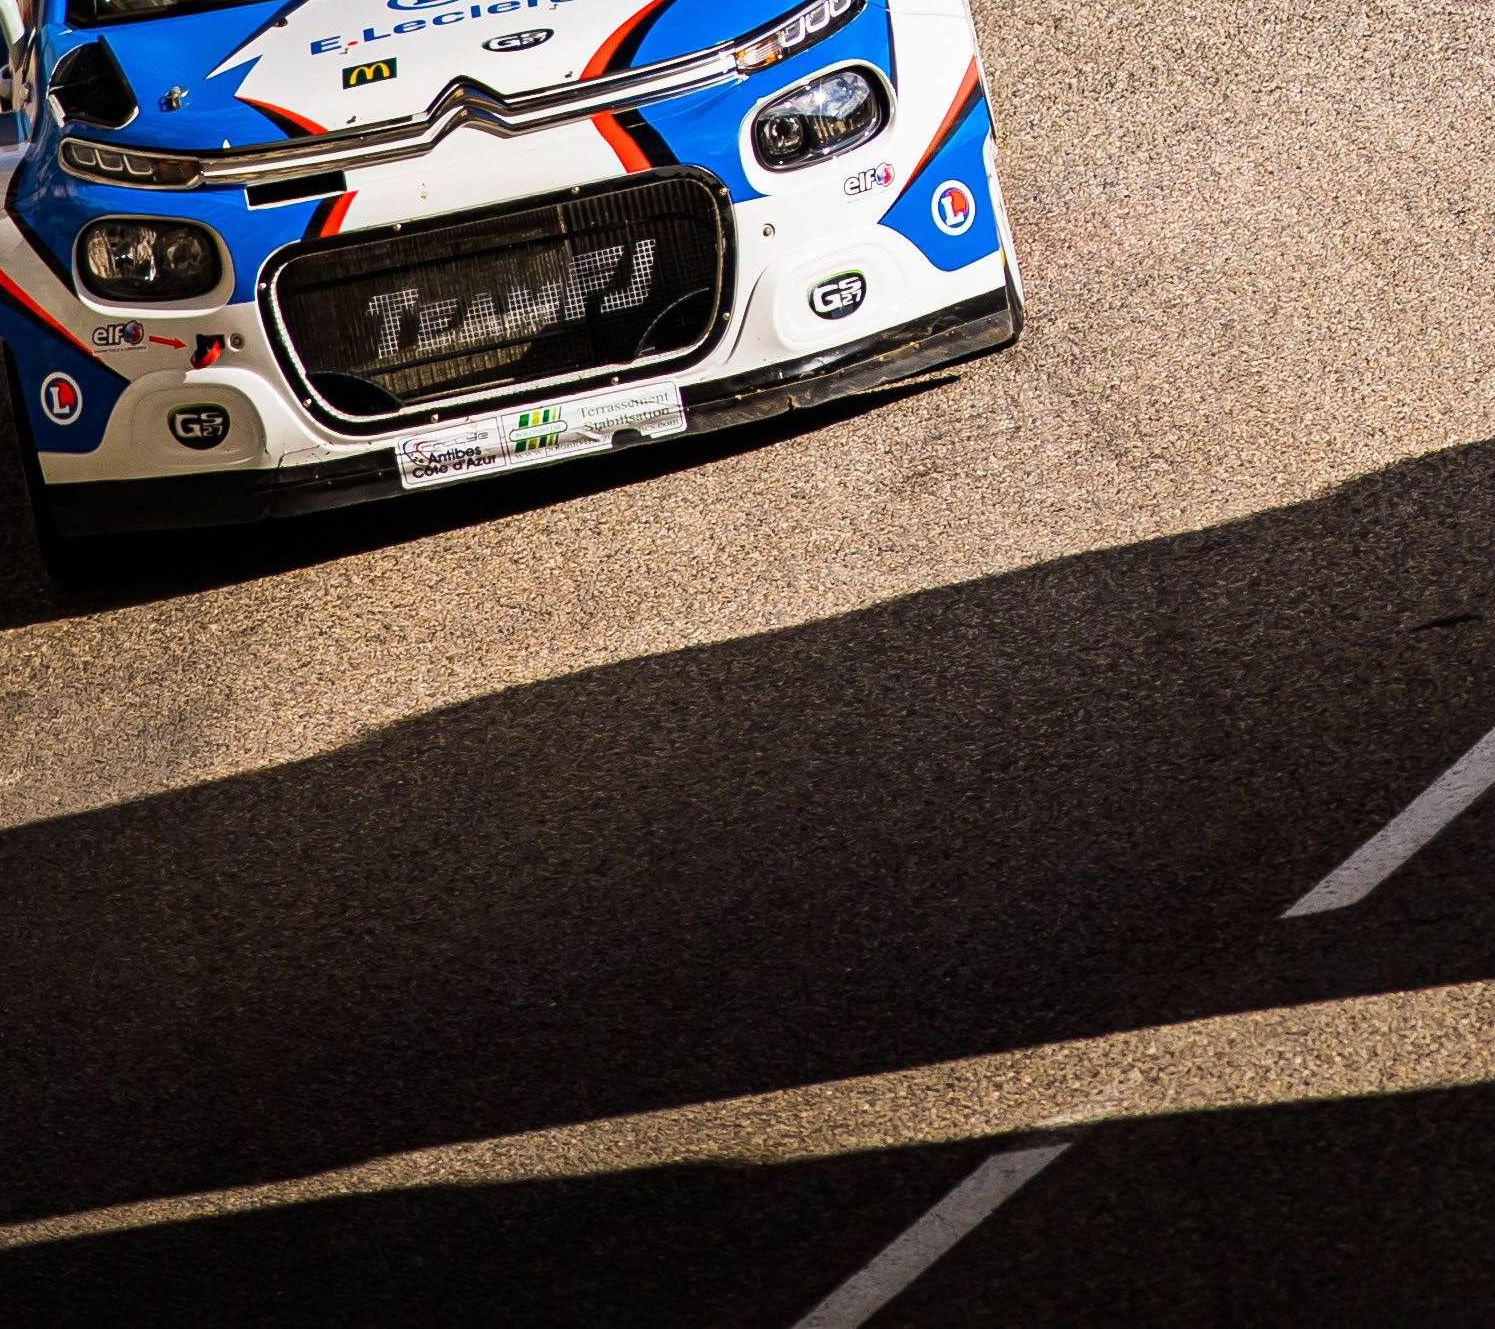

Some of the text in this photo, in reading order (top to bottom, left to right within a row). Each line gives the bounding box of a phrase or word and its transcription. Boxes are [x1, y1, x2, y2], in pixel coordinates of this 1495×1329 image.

[844, 167, 876, 196] elf
[91, 322, 125, 347] elf
[579, 392, 670, 419] Terrassement
[411, 454, 497, 479] Côte d'Azur
[428, 446, 482, 465] Antibes
